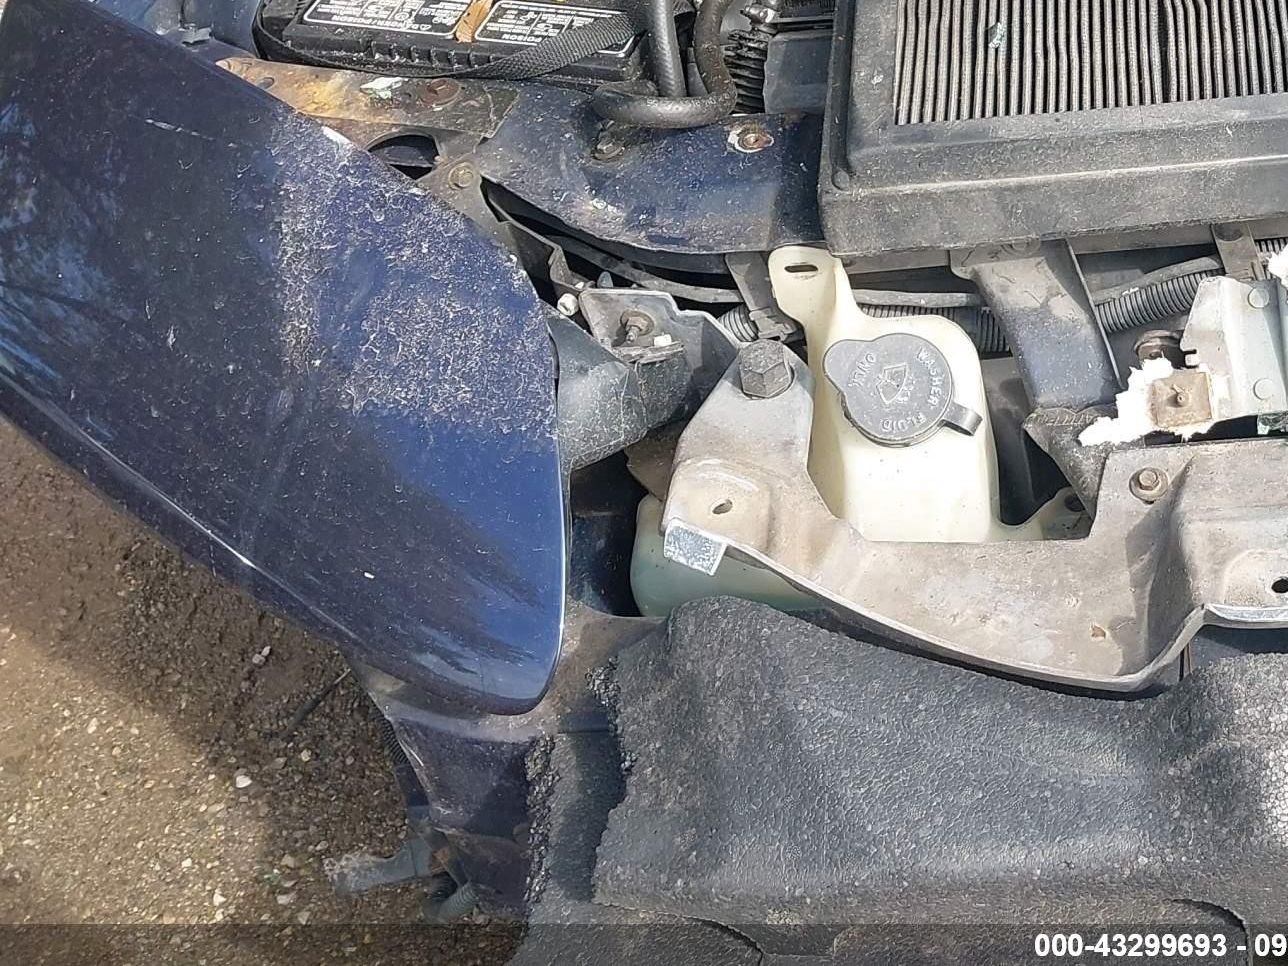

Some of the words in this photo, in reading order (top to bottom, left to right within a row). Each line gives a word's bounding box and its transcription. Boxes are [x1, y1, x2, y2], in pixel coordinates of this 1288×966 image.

[501, 33, 543, 43] POISON
[847, 351, 877, 388] ONLY
[915, 347, 944, 409] WASHER
[880, 411, 928, 433] FLUID
